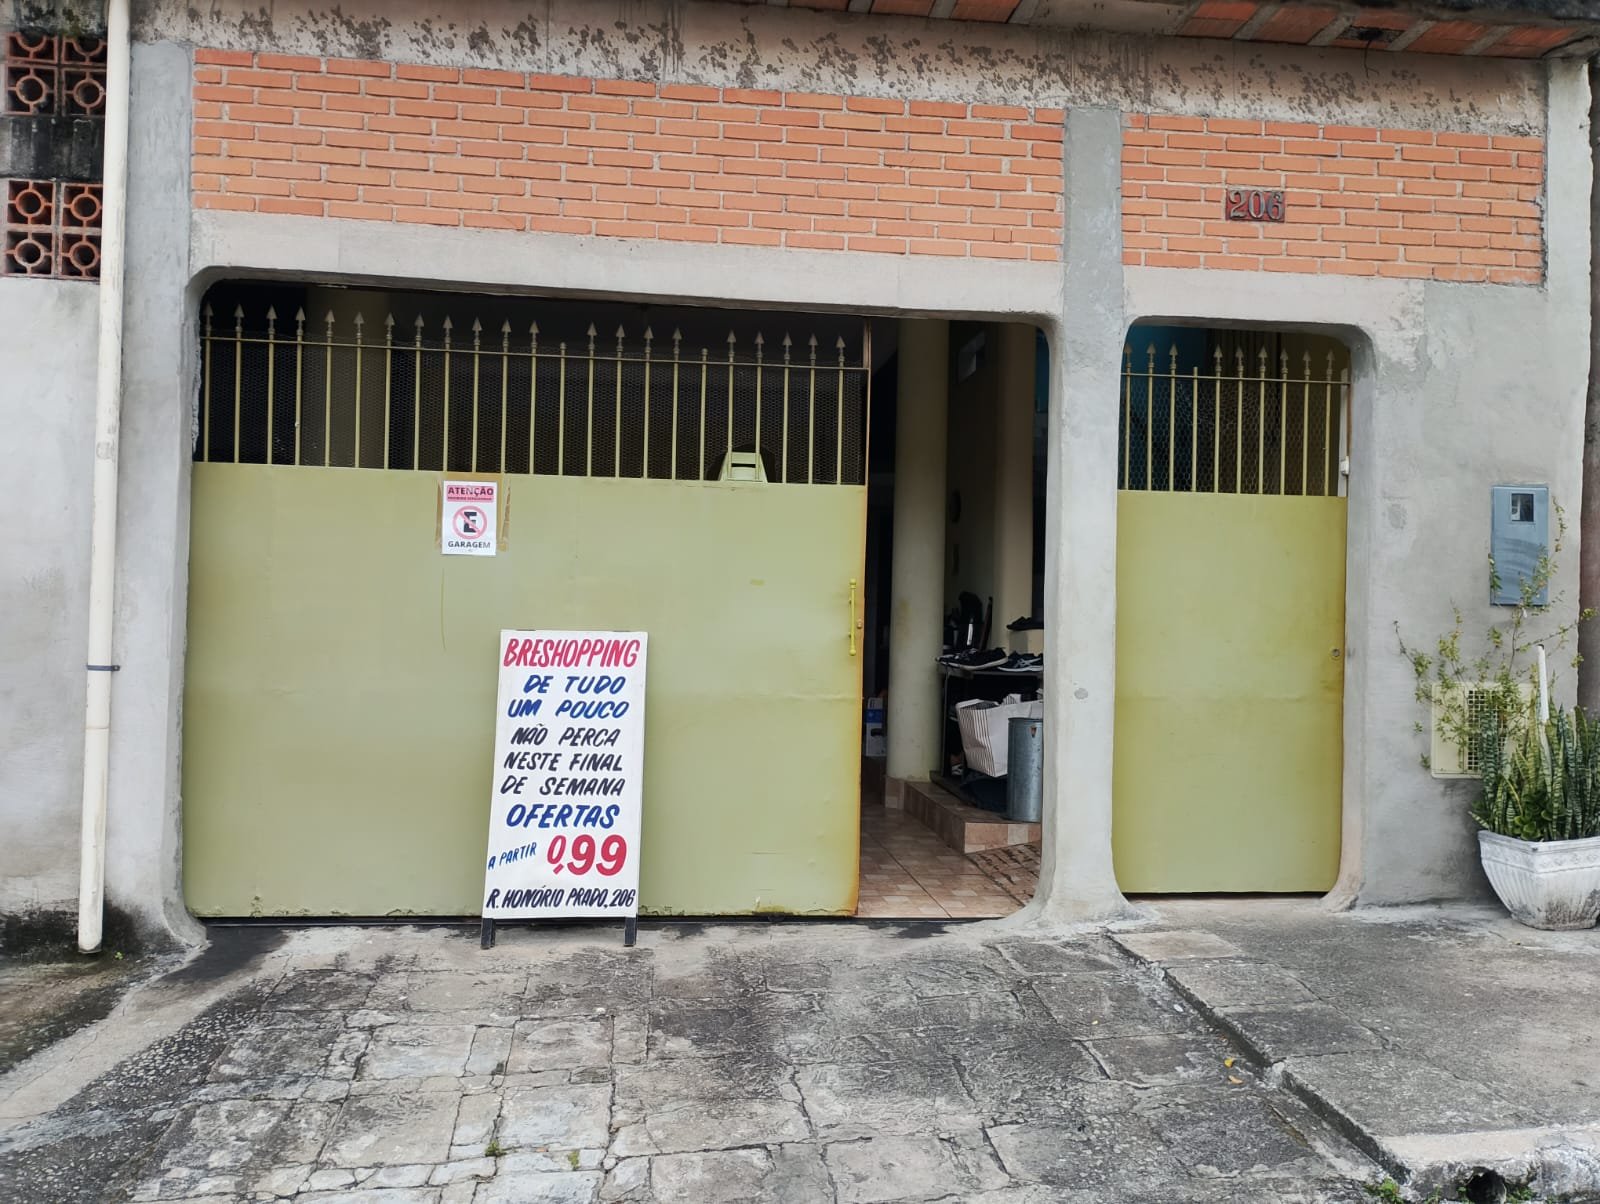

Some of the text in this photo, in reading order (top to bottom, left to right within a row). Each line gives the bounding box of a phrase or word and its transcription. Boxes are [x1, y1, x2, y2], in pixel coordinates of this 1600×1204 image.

[1229, 190, 1284, 220] 206
[447, 486, 494, 497] ATENÇÃO
[447, 540, 491, 549] GARAGEM
[503, 638, 641, 668] BRESHOPPING
[523, 674, 626, 695] DE TUDO
[507, 698, 630, 719] UM POUCO
[510, 722, 621, 748] NÃO PERCA
[503, 751, 623, 772] NESTE FINAL
[500, 775, 626, 796] DE SEMANA
[506, 803, 621, 829] OFERTAS
[487, 834, 627, 876] A PARTIR 0,99
[501, 885, 565, 909] HONÓRIO
